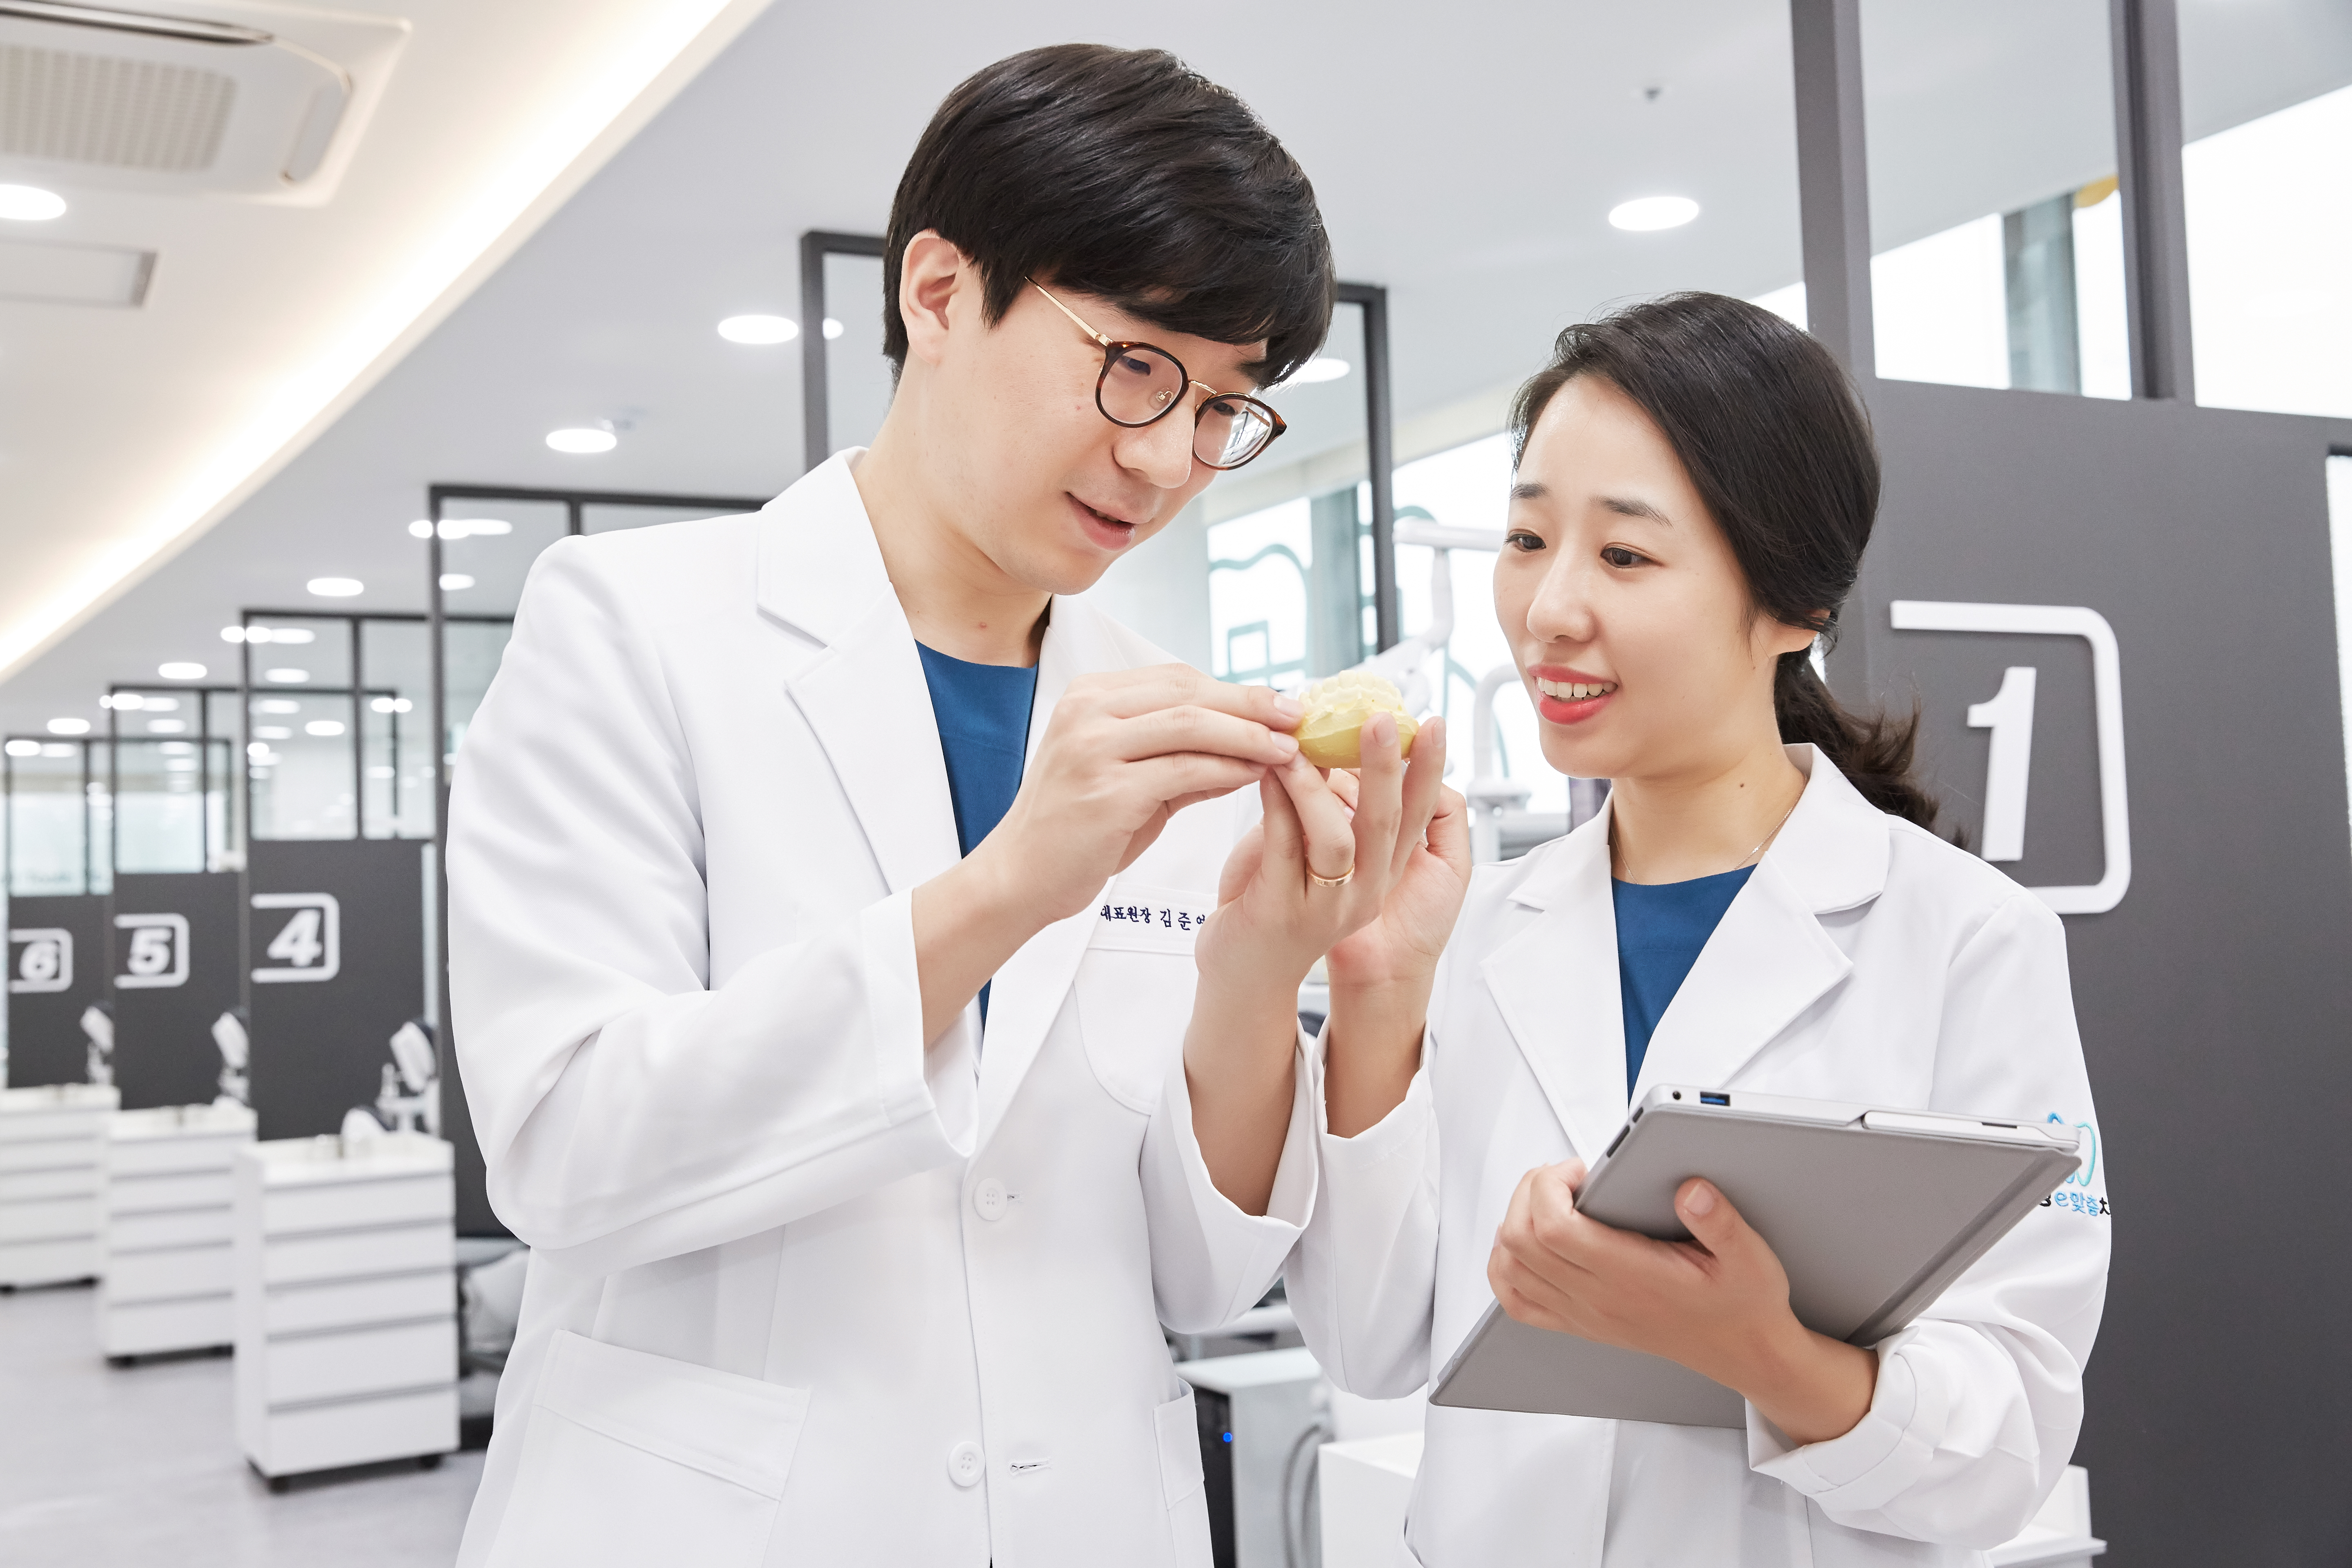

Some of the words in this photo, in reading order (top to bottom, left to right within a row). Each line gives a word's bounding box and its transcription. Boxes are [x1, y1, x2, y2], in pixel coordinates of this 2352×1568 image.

[1967, 666, 2037, 861] 1
[267, 908, 323, 967] 4
[1100, 904, 1152, 924] 대표원장
[19, 940, 59, 981] 6
[127, 927, 173, 976] 5
